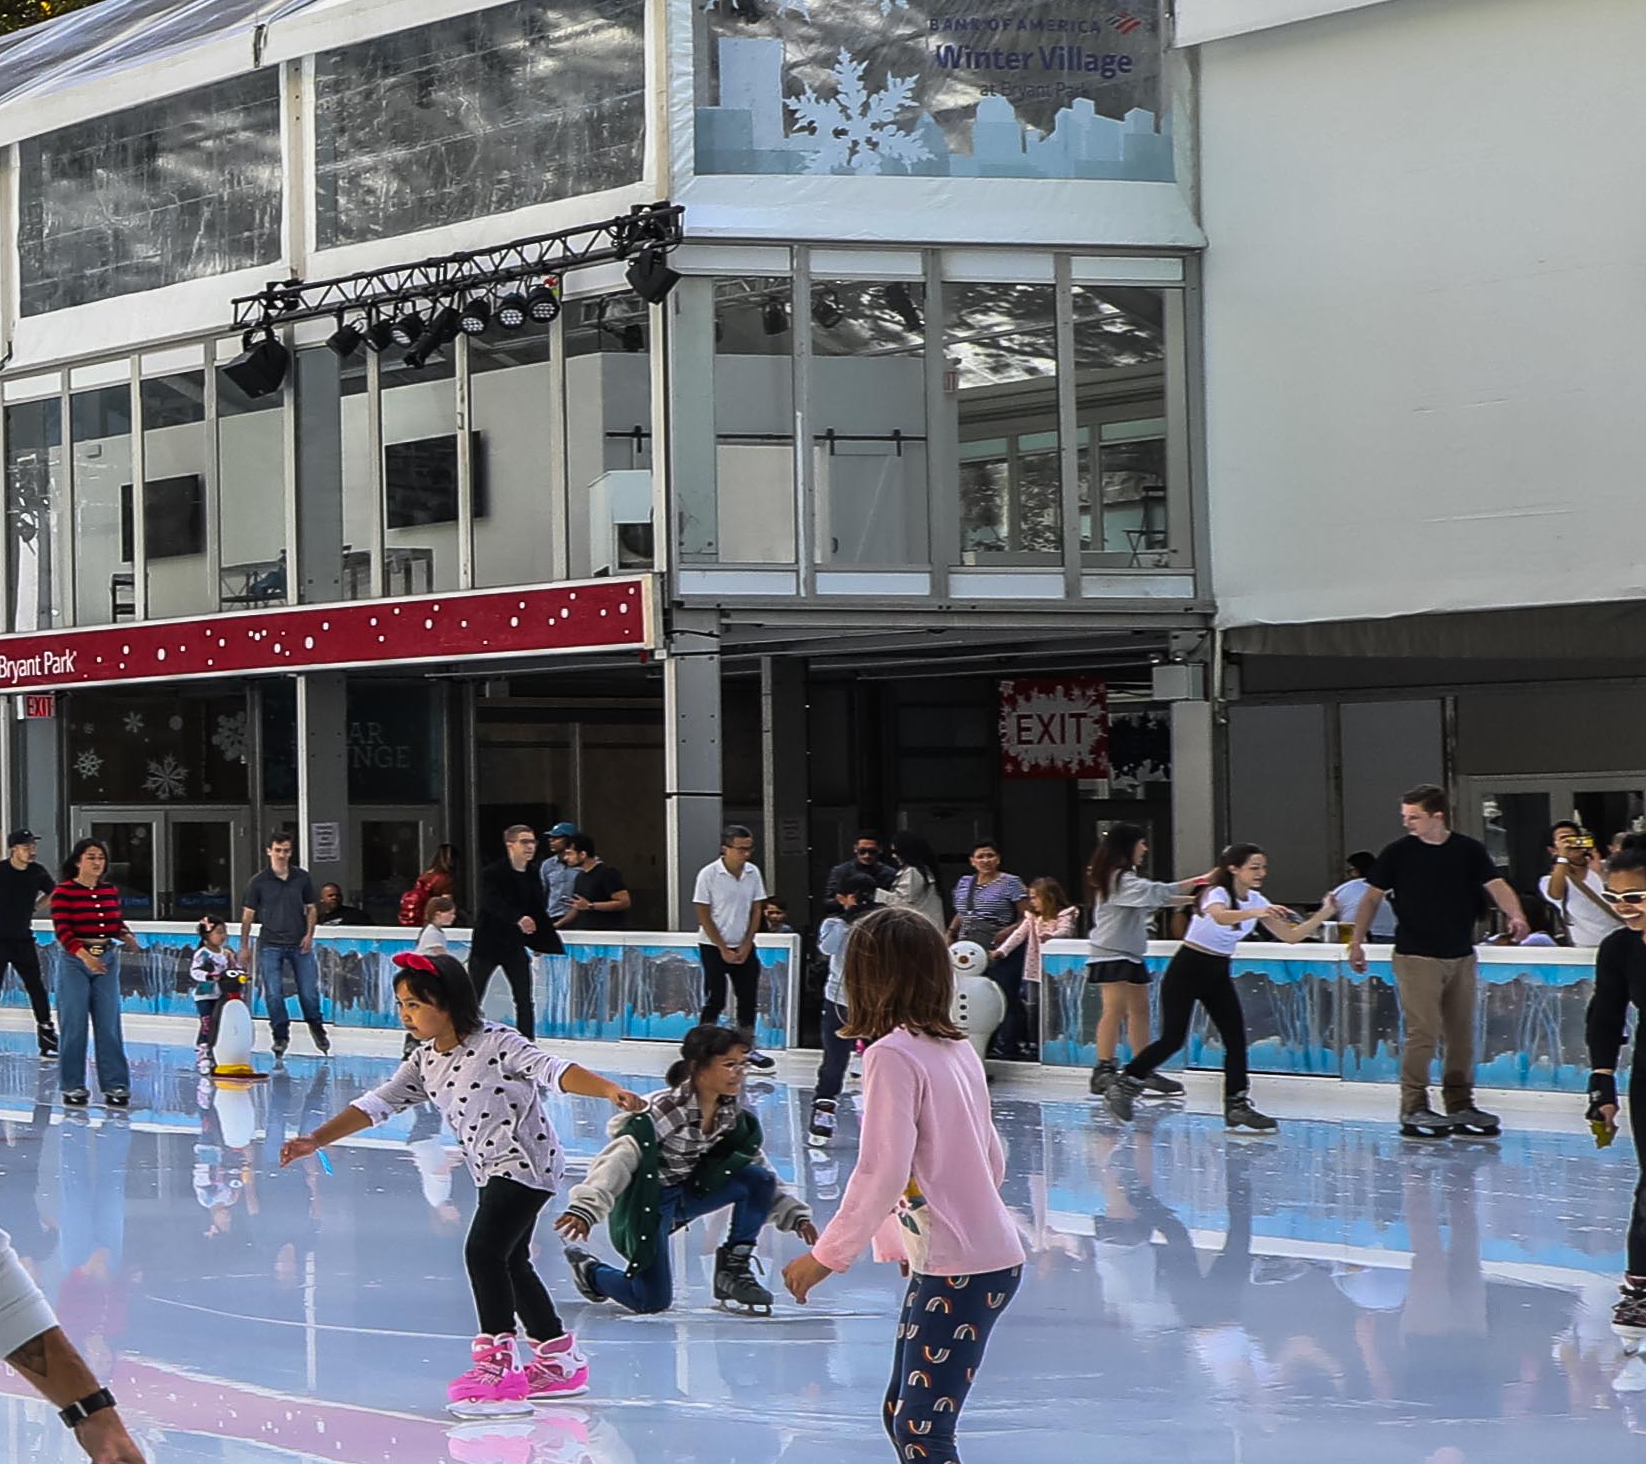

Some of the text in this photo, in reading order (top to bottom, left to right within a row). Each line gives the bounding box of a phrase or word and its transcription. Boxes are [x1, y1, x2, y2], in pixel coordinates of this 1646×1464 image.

[929, 18, 1102, 34] BANK OF AMERICA
[936, 45, 1133, 79] Winter Village
[43, 650, 74, 676] Park
[28, 697, 55, 716] EXIT
[1015, 712, 1088, 746] EXIT
